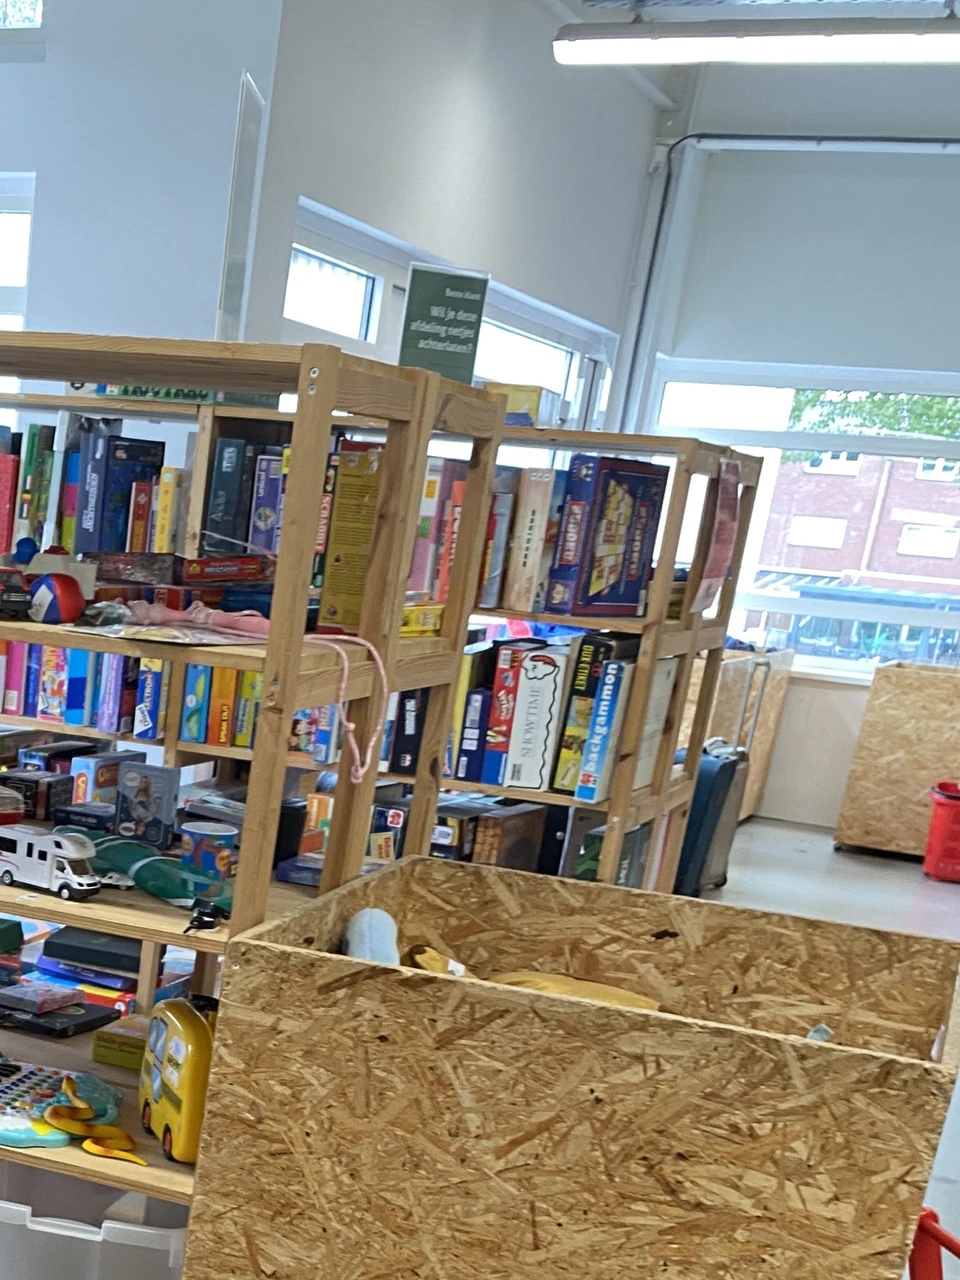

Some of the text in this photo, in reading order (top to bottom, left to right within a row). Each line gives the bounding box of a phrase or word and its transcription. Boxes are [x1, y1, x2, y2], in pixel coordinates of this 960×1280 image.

[219, 704, 230, 742] SPEAK OUT
[520, 689, 541, 758] SHOWTIME
[582, 664, 619, 771] backgammon
